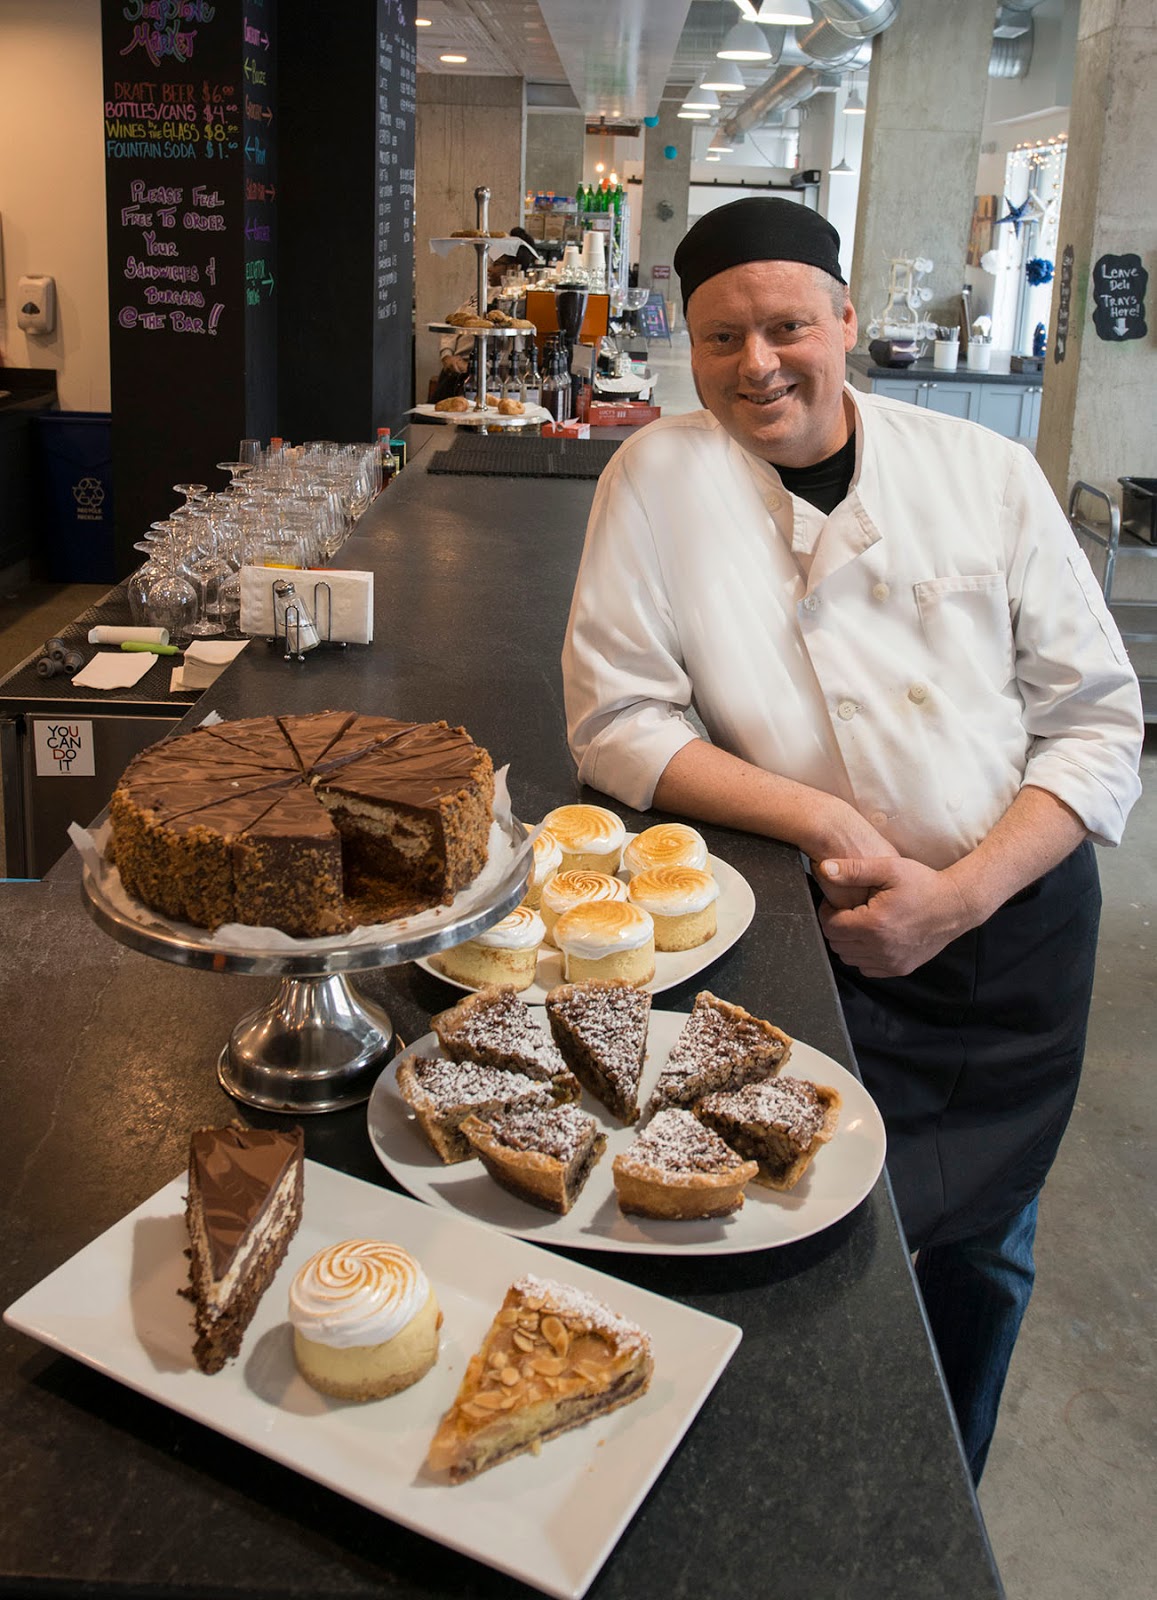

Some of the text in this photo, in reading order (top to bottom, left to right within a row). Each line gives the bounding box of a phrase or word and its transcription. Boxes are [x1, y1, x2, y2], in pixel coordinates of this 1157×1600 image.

[114, 82, 157, 101] DRAFT
[162, 83, 197, 103] BEER
[105, 102, 197, 121] BOTTLES/CANS
[105, 119, 146, 138] WINES
[163, 121, 200, 142] GLASS
[106, 141, 161, 159] FOUNTAIN
[164, 141, 196, 159] SODA
[130, 179, 184, 204] PLEASE
[121, 205, 226, 231] FREE TO ORDER
[142, 230, 179, 256] YOUR
[1110, 279, 1130, 291] Deli
[47, 725, 79, 738] YOU
[47, 736, 81, 749] CAN
[53, 749, 77, 760] DO
[59, 759, 73, 771] IT
